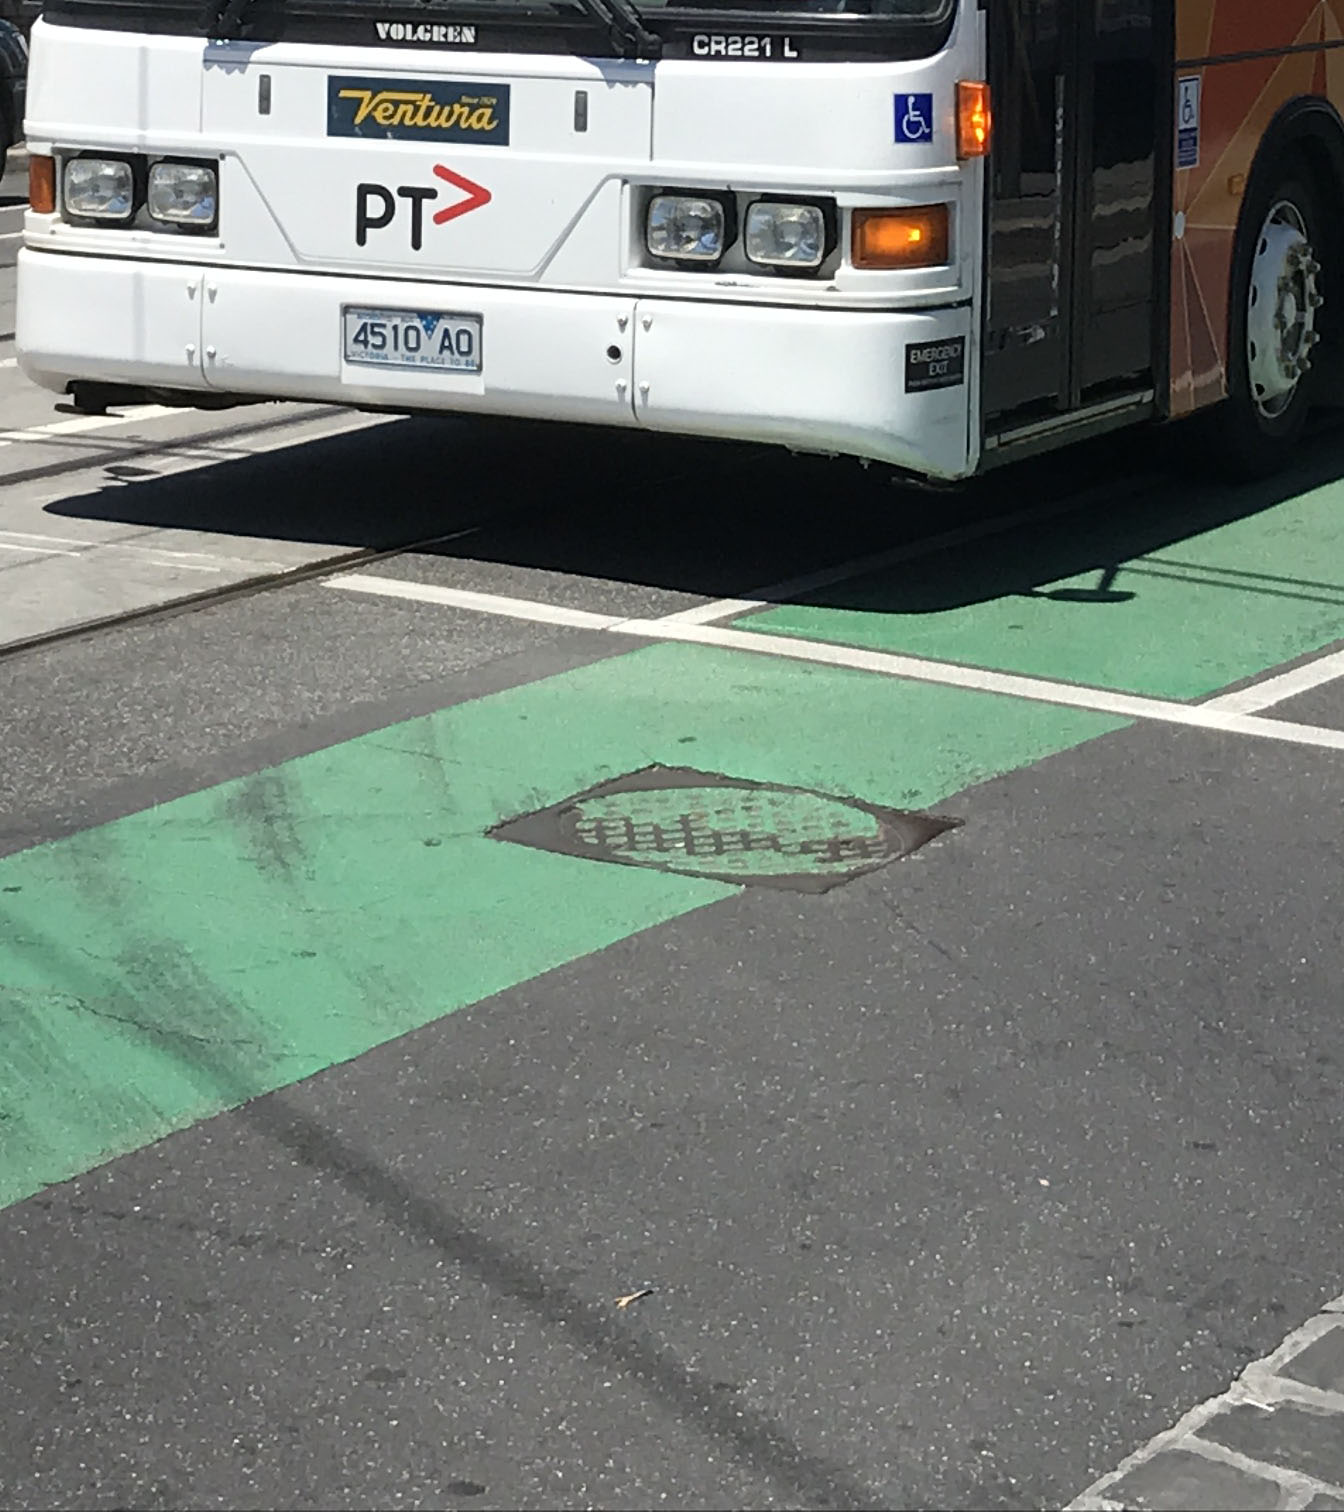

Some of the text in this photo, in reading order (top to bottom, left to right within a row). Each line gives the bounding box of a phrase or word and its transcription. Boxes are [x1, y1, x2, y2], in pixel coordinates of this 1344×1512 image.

[375, 22, 476, 44] VOLGREN
[692, 34, 798, 58] CR221 L
[337, 88, 500, 131] Ventura
[352, 321, 422, 353] 4510
